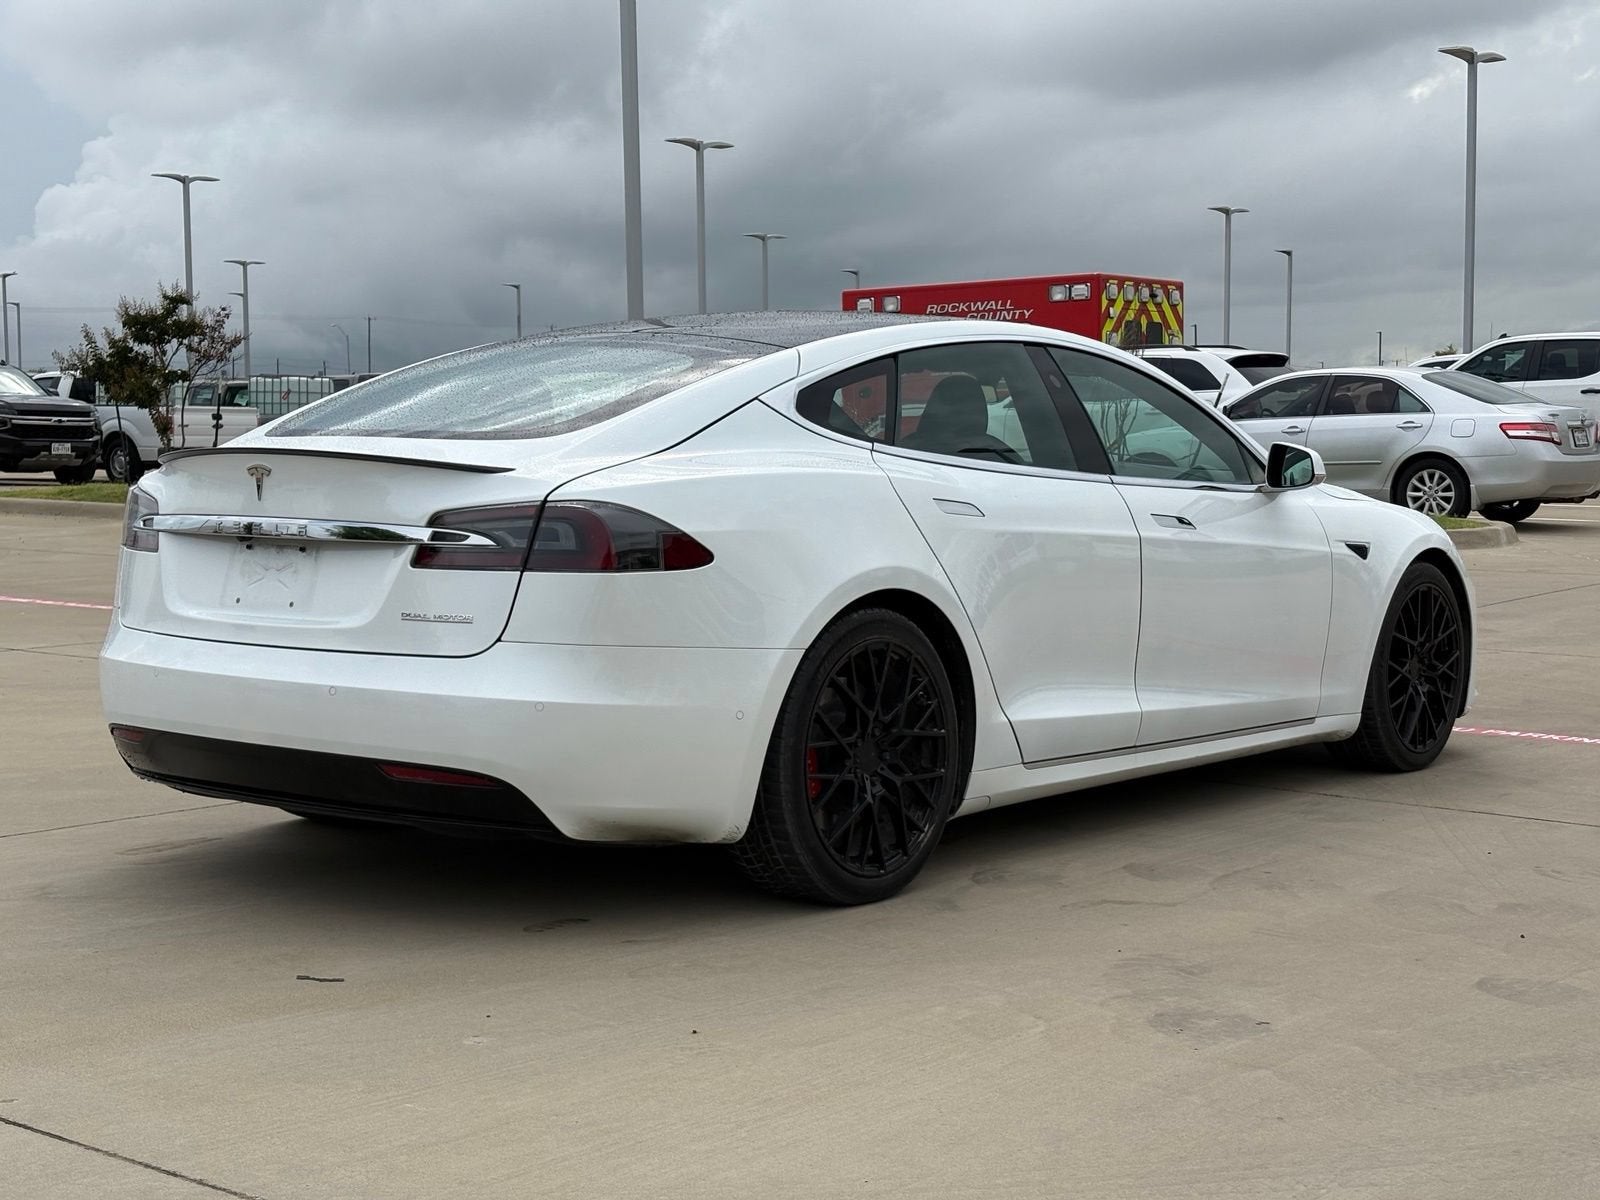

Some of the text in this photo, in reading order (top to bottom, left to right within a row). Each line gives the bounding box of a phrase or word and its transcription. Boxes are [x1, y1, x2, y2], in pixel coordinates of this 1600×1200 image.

[926, 299, 1015, 315] ROCKWALL
[966, 308, 1034, 321] COUNTY
[401, 611, 474, 622] DUAL MOTOR
